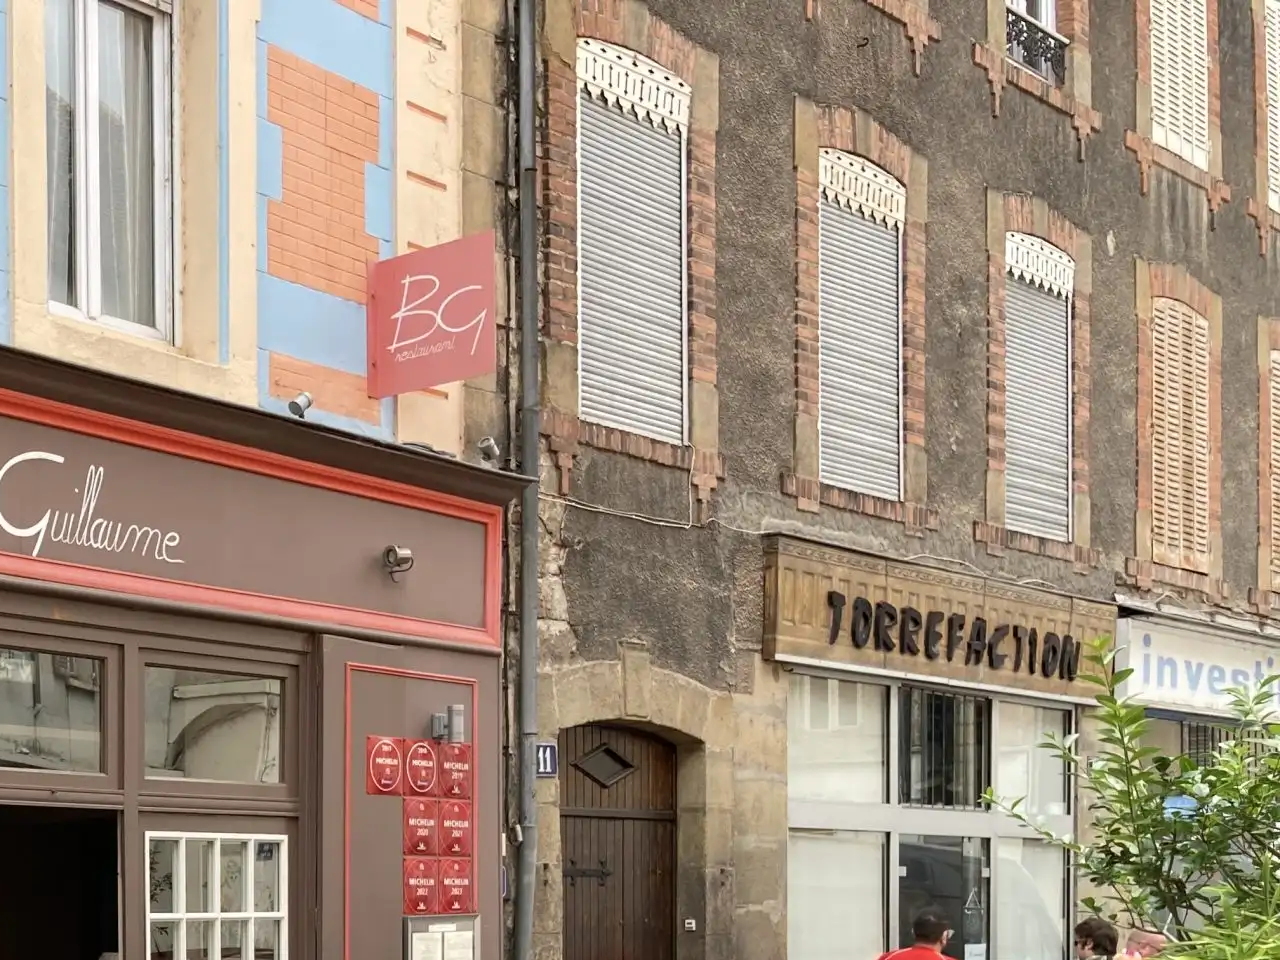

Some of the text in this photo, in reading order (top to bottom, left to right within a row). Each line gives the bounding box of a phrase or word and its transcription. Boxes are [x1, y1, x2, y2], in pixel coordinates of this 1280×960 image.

[386, 274, 488, 356] BG
[827, 590, 1081, 682] TORREFACTION
[375, 757, 399, 766] MICHELIN
[411, 759, 434, 767] MICHELIN
[537, 746, 552, 773] 11
[443, 761, 469, 771] MICHELIN
[408, 818, 435, 827] MICHELIN
[443, 819, 469, 828] MICHELIN
[408, 877, 435, 886] MICHELIN
[443, 877, 469, 886] MICHELIN
